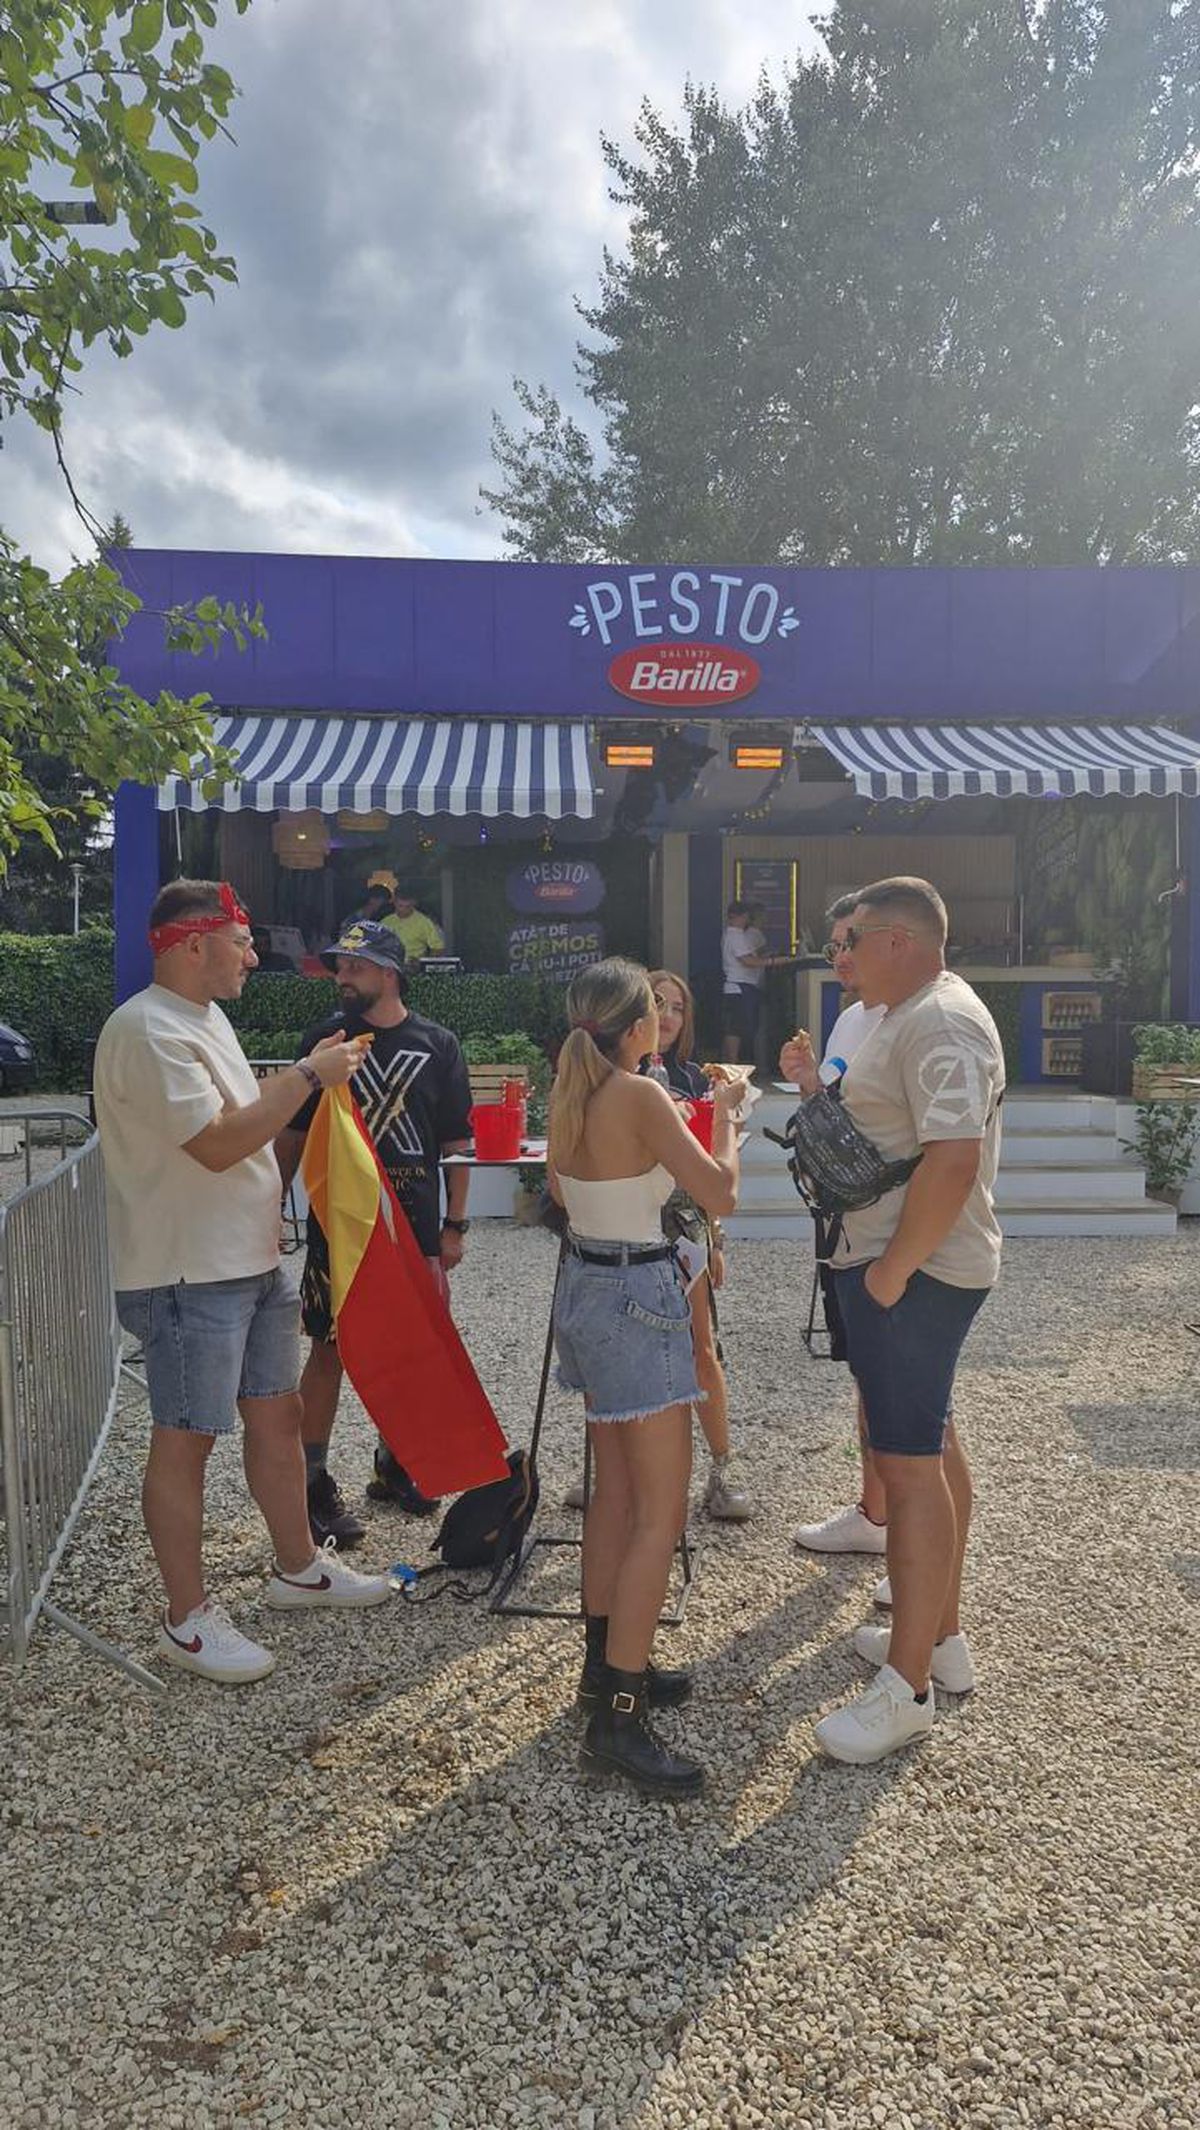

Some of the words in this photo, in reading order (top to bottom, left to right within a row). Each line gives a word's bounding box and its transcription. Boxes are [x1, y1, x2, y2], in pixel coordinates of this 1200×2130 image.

[587, 572, 779, 644] PESTO
[630, 661, 740, 691] Barilla
[529, 861, 585, 884] PESTO
[548, 923, 569, 937] DE
